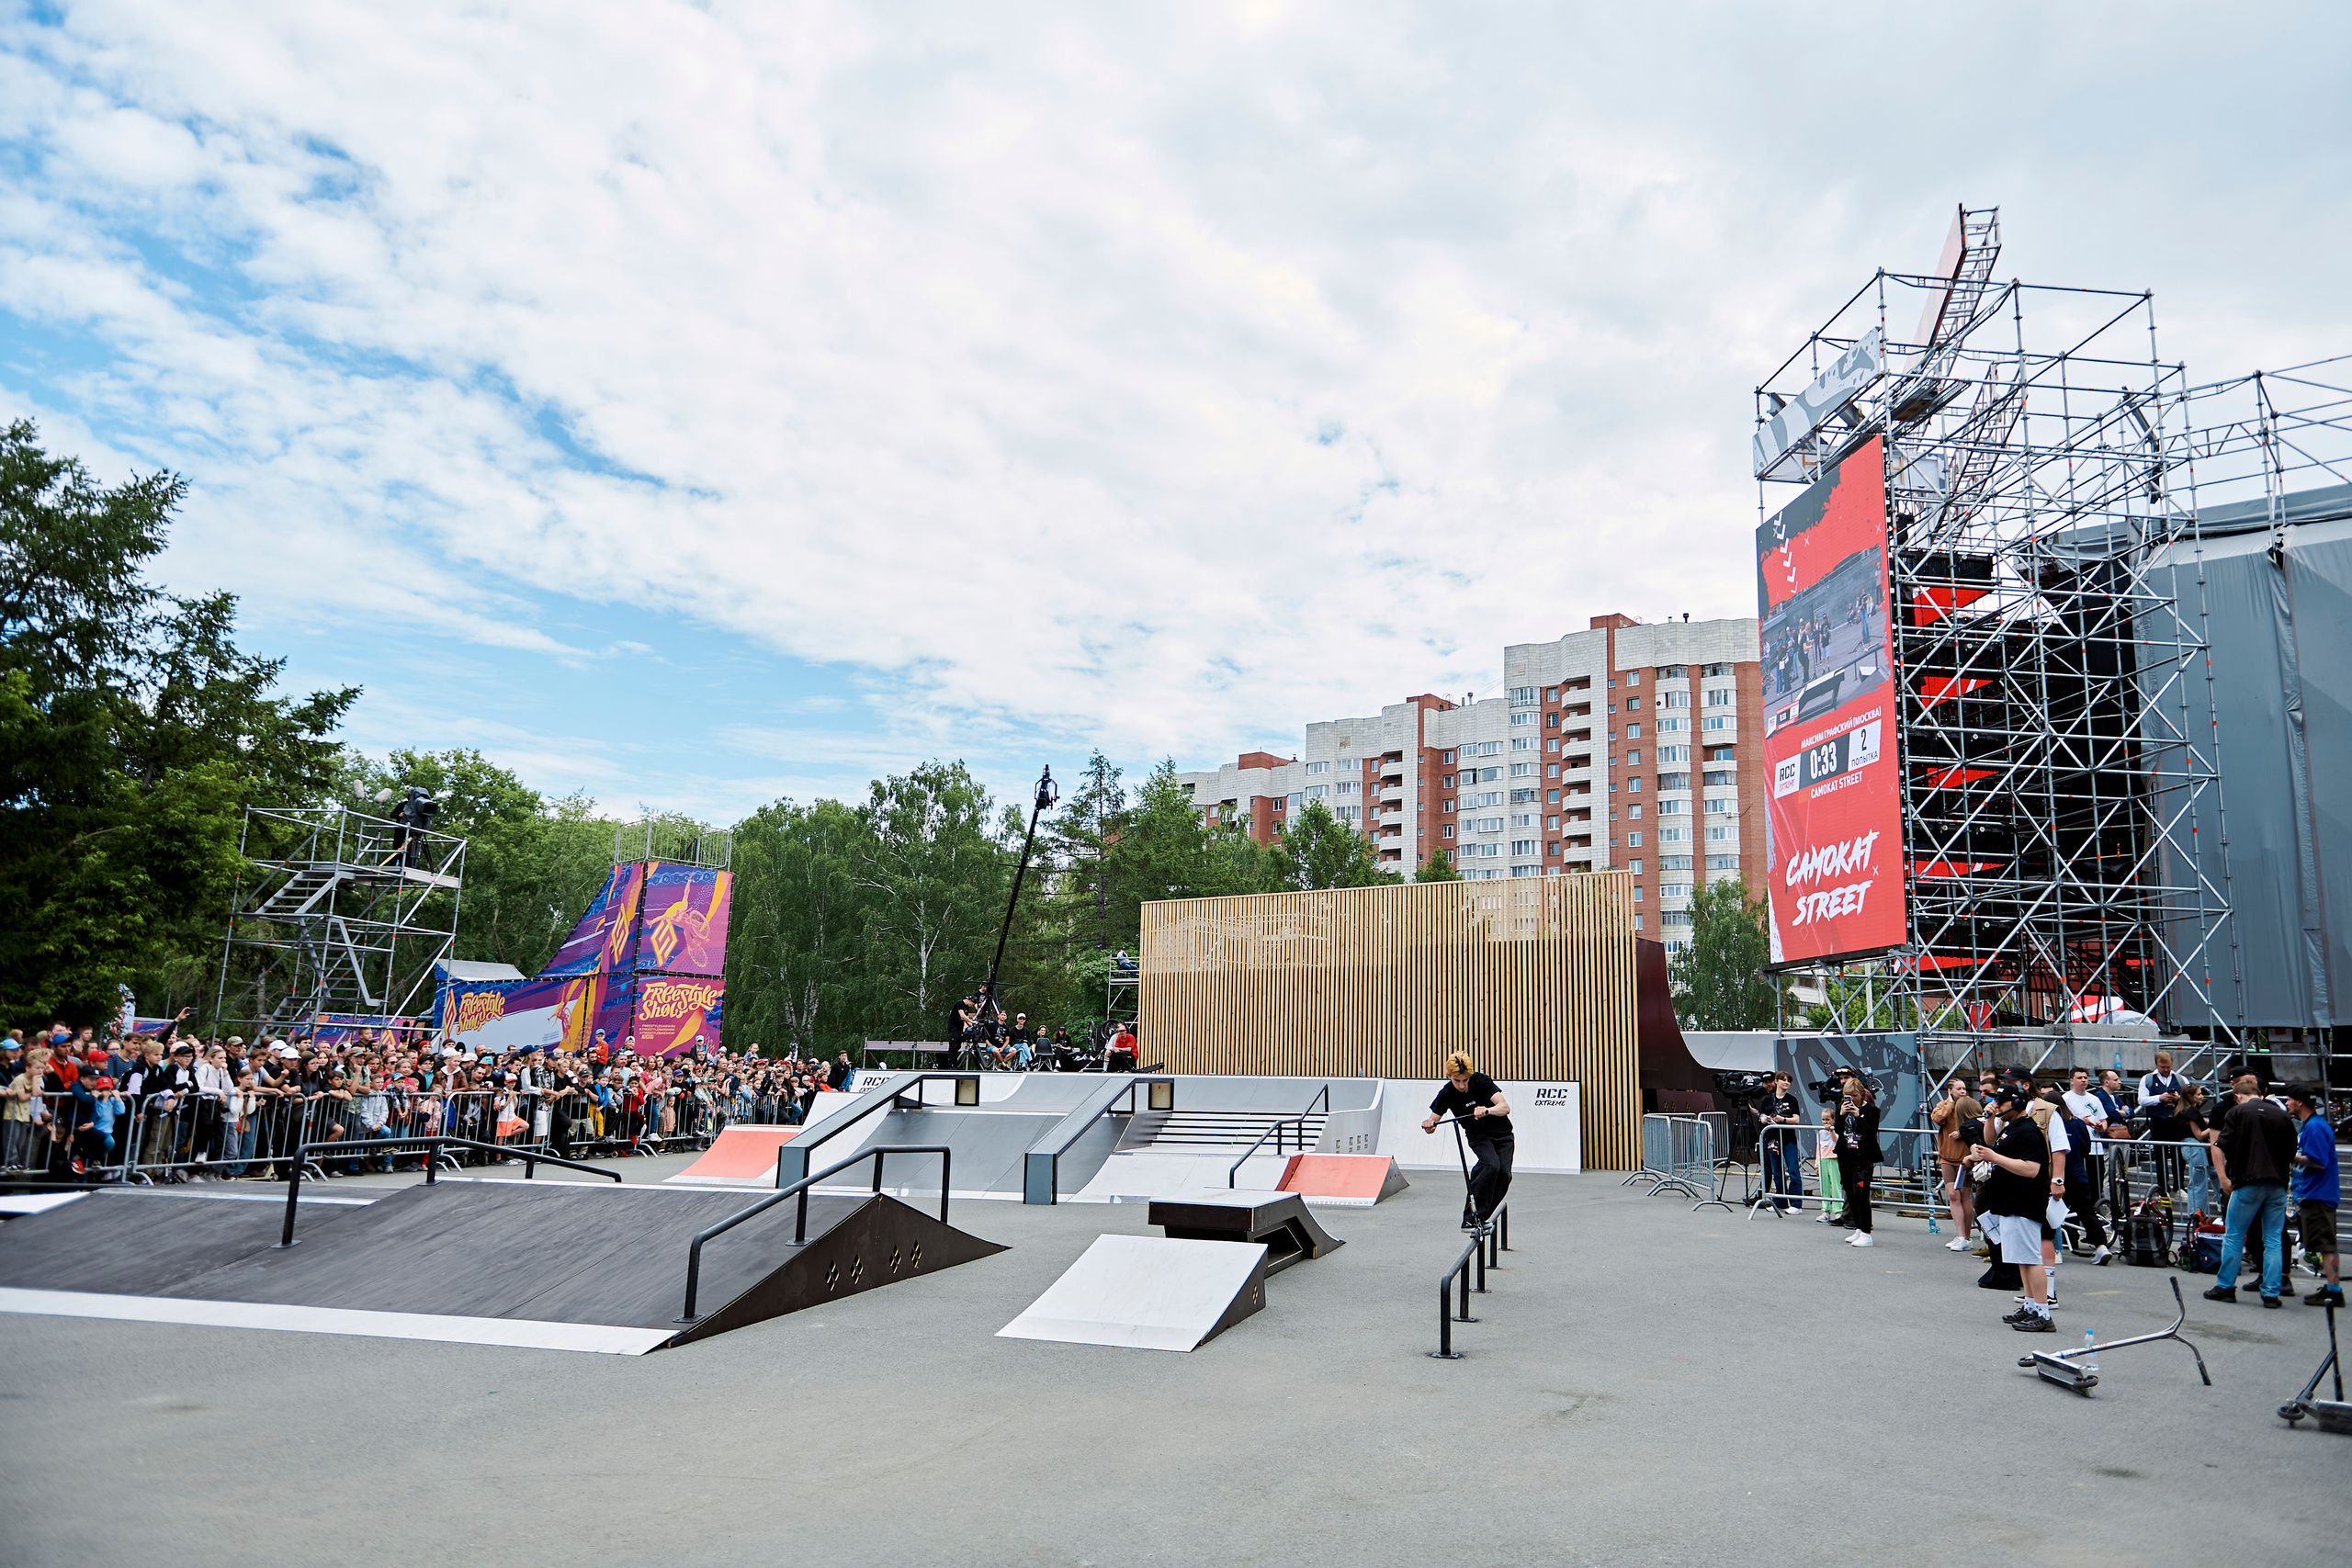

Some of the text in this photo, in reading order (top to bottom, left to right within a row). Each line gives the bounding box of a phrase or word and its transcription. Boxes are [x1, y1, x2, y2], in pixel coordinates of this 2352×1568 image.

[1801, 731, 1824, 749] МАКСИМ
[1860, 728, 1867, 751] 2
[1810, 741, 1838, 779] 0:33
[1851, 750, 1879, 768] ПОПЫТКА
[1779, 763, 1795, 782] RCC
[1811, 771, 1863, 799] САМОКАТ STREET
[1786, 829, 1880, 886] САМОКАТ
[1792, 880, 1873, 926] STREET
[1536, 1089, 1568, 1099] RCC
